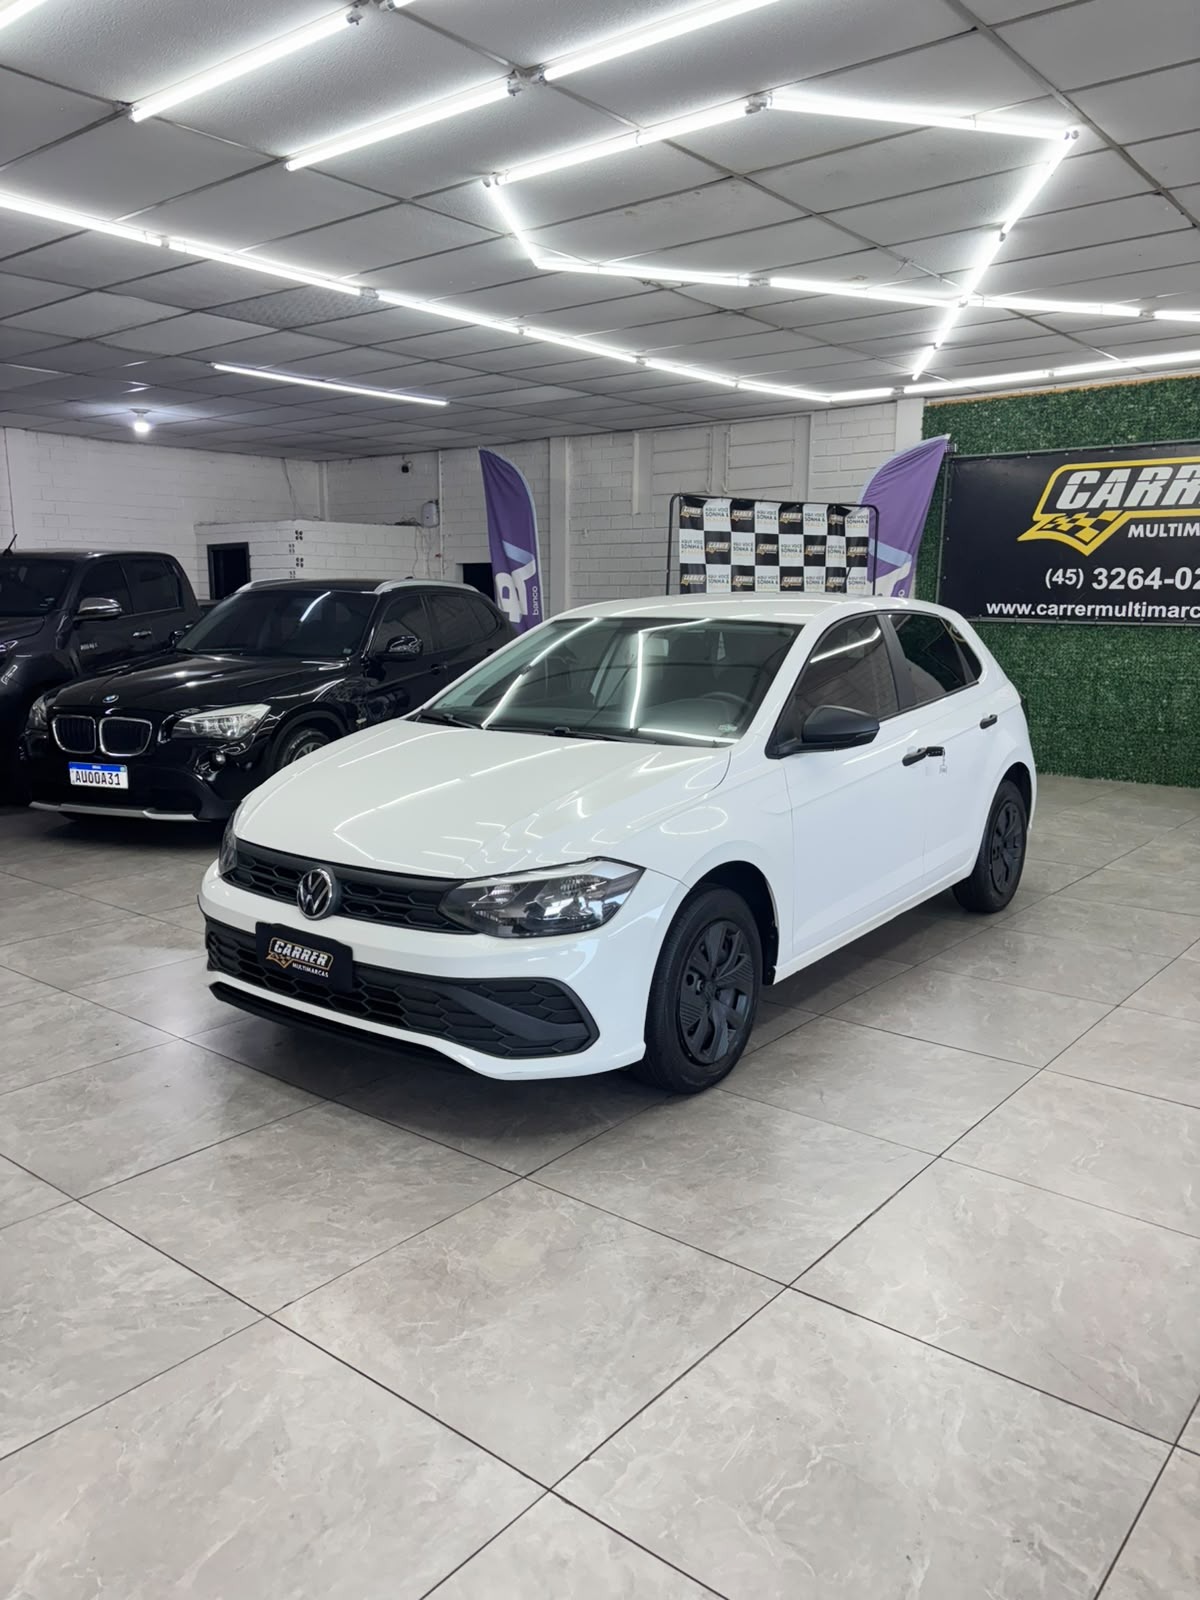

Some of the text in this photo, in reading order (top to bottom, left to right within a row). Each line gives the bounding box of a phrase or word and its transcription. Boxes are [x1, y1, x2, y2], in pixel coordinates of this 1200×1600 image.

[1056, 467, 1200, 510] CARR
[1128, 523, 1200, 538] MULTIM
[1046, 568, 1084, 589] (45)
[986, 602, 1200, 618] www.carrermultimarc
[274, 940, 328, 966] CARRER
[292, 962, 329, 978] MULTIMARCAS
